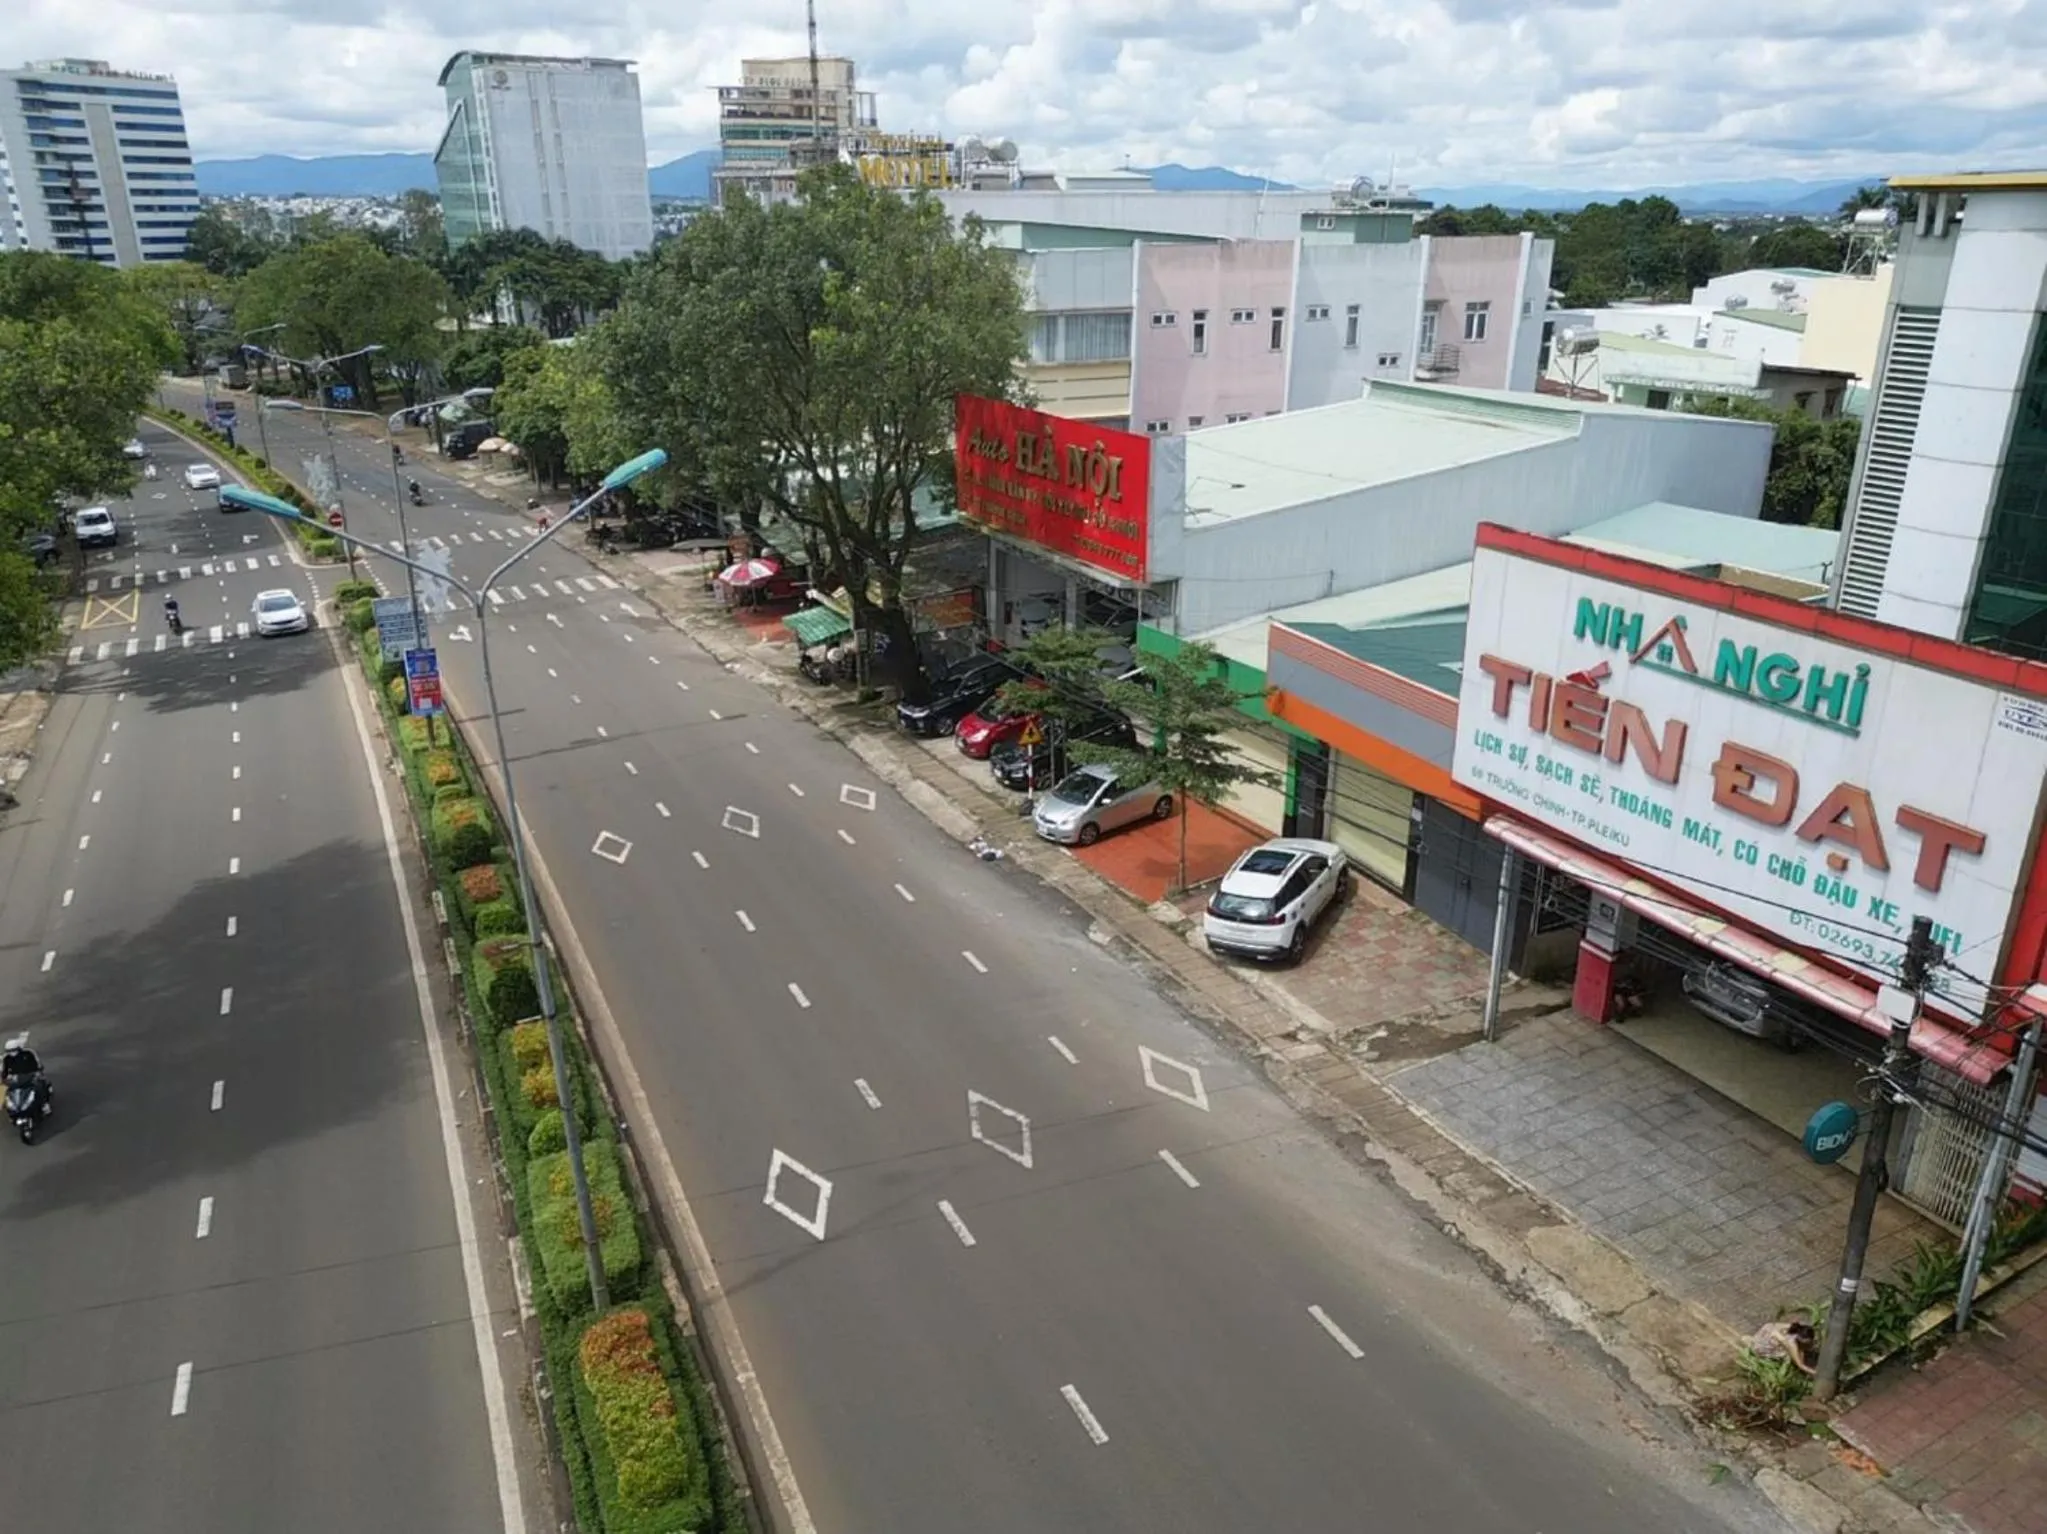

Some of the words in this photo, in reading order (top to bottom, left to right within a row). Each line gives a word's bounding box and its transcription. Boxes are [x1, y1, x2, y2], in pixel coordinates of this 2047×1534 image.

[1015, 425, 1060, 480] HÀ
[1066, 440, 1123, 508] NỘI
[1714, 638, 1871, 727] NGHỈ
[1474, 729, 1503, 755] LỊCH
[1535, 754, 1573, 787] SẠCH
[1610, 785, 1673, 830] THOÁNG
[1682, 816, 1723, 856] MÁT,
[1734, 840, 1758, 866] CÓ
[1767, 853, 1806, 886] CHỖ
[1867, 895, 1904, 934] XE,
[1479, 652, 1688, 785] TIẾN
[1712, 740, 1987, 895] ĐẠT
